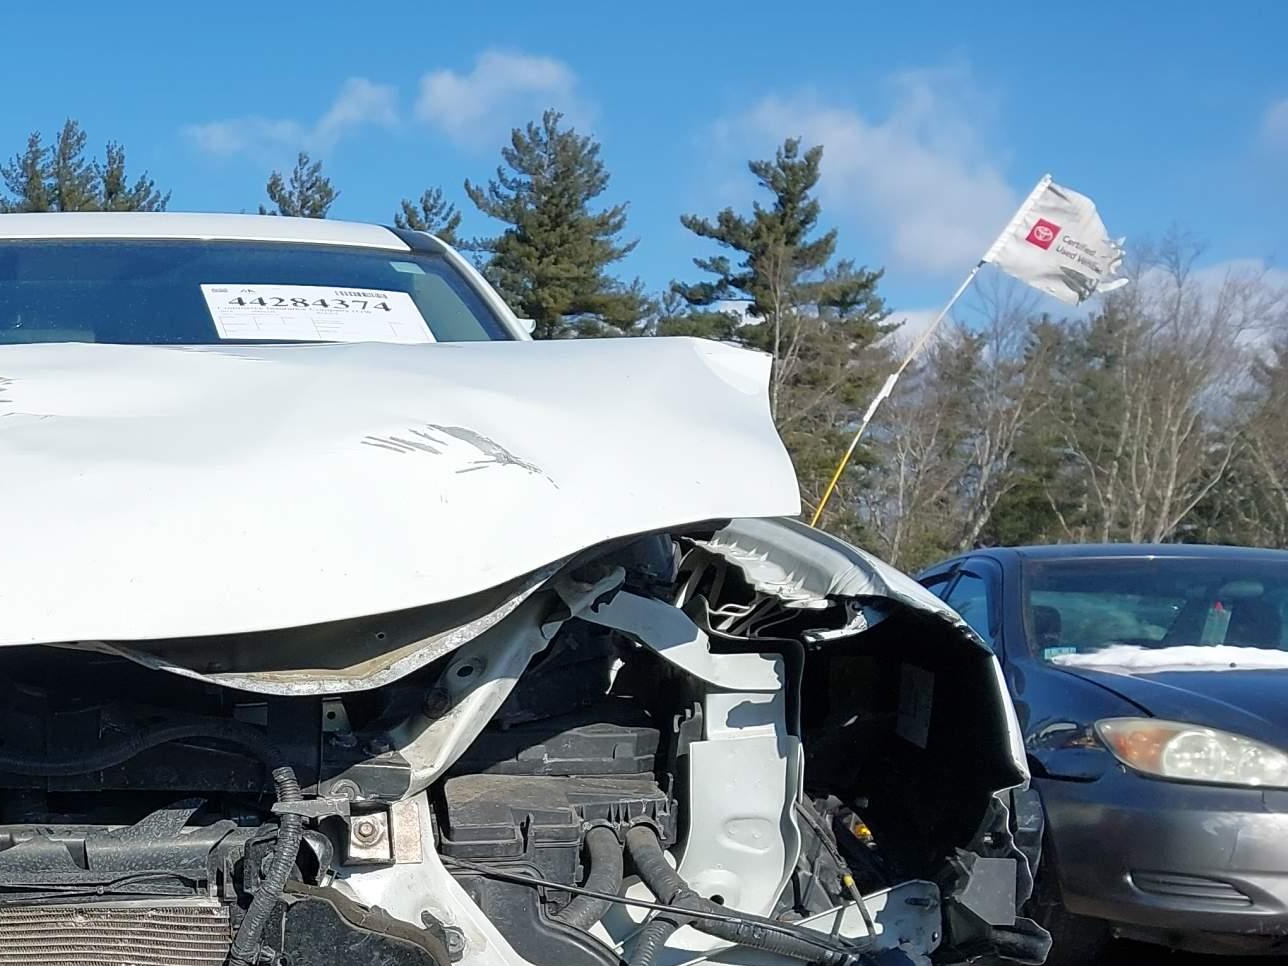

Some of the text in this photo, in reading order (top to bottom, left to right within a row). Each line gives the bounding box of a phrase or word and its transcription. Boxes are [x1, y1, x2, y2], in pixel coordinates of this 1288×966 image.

[1056, 245, 1077, 260] Used
[1062, 235, 1096, 256] Certified
[228, 296, 392, 312] 44284374
